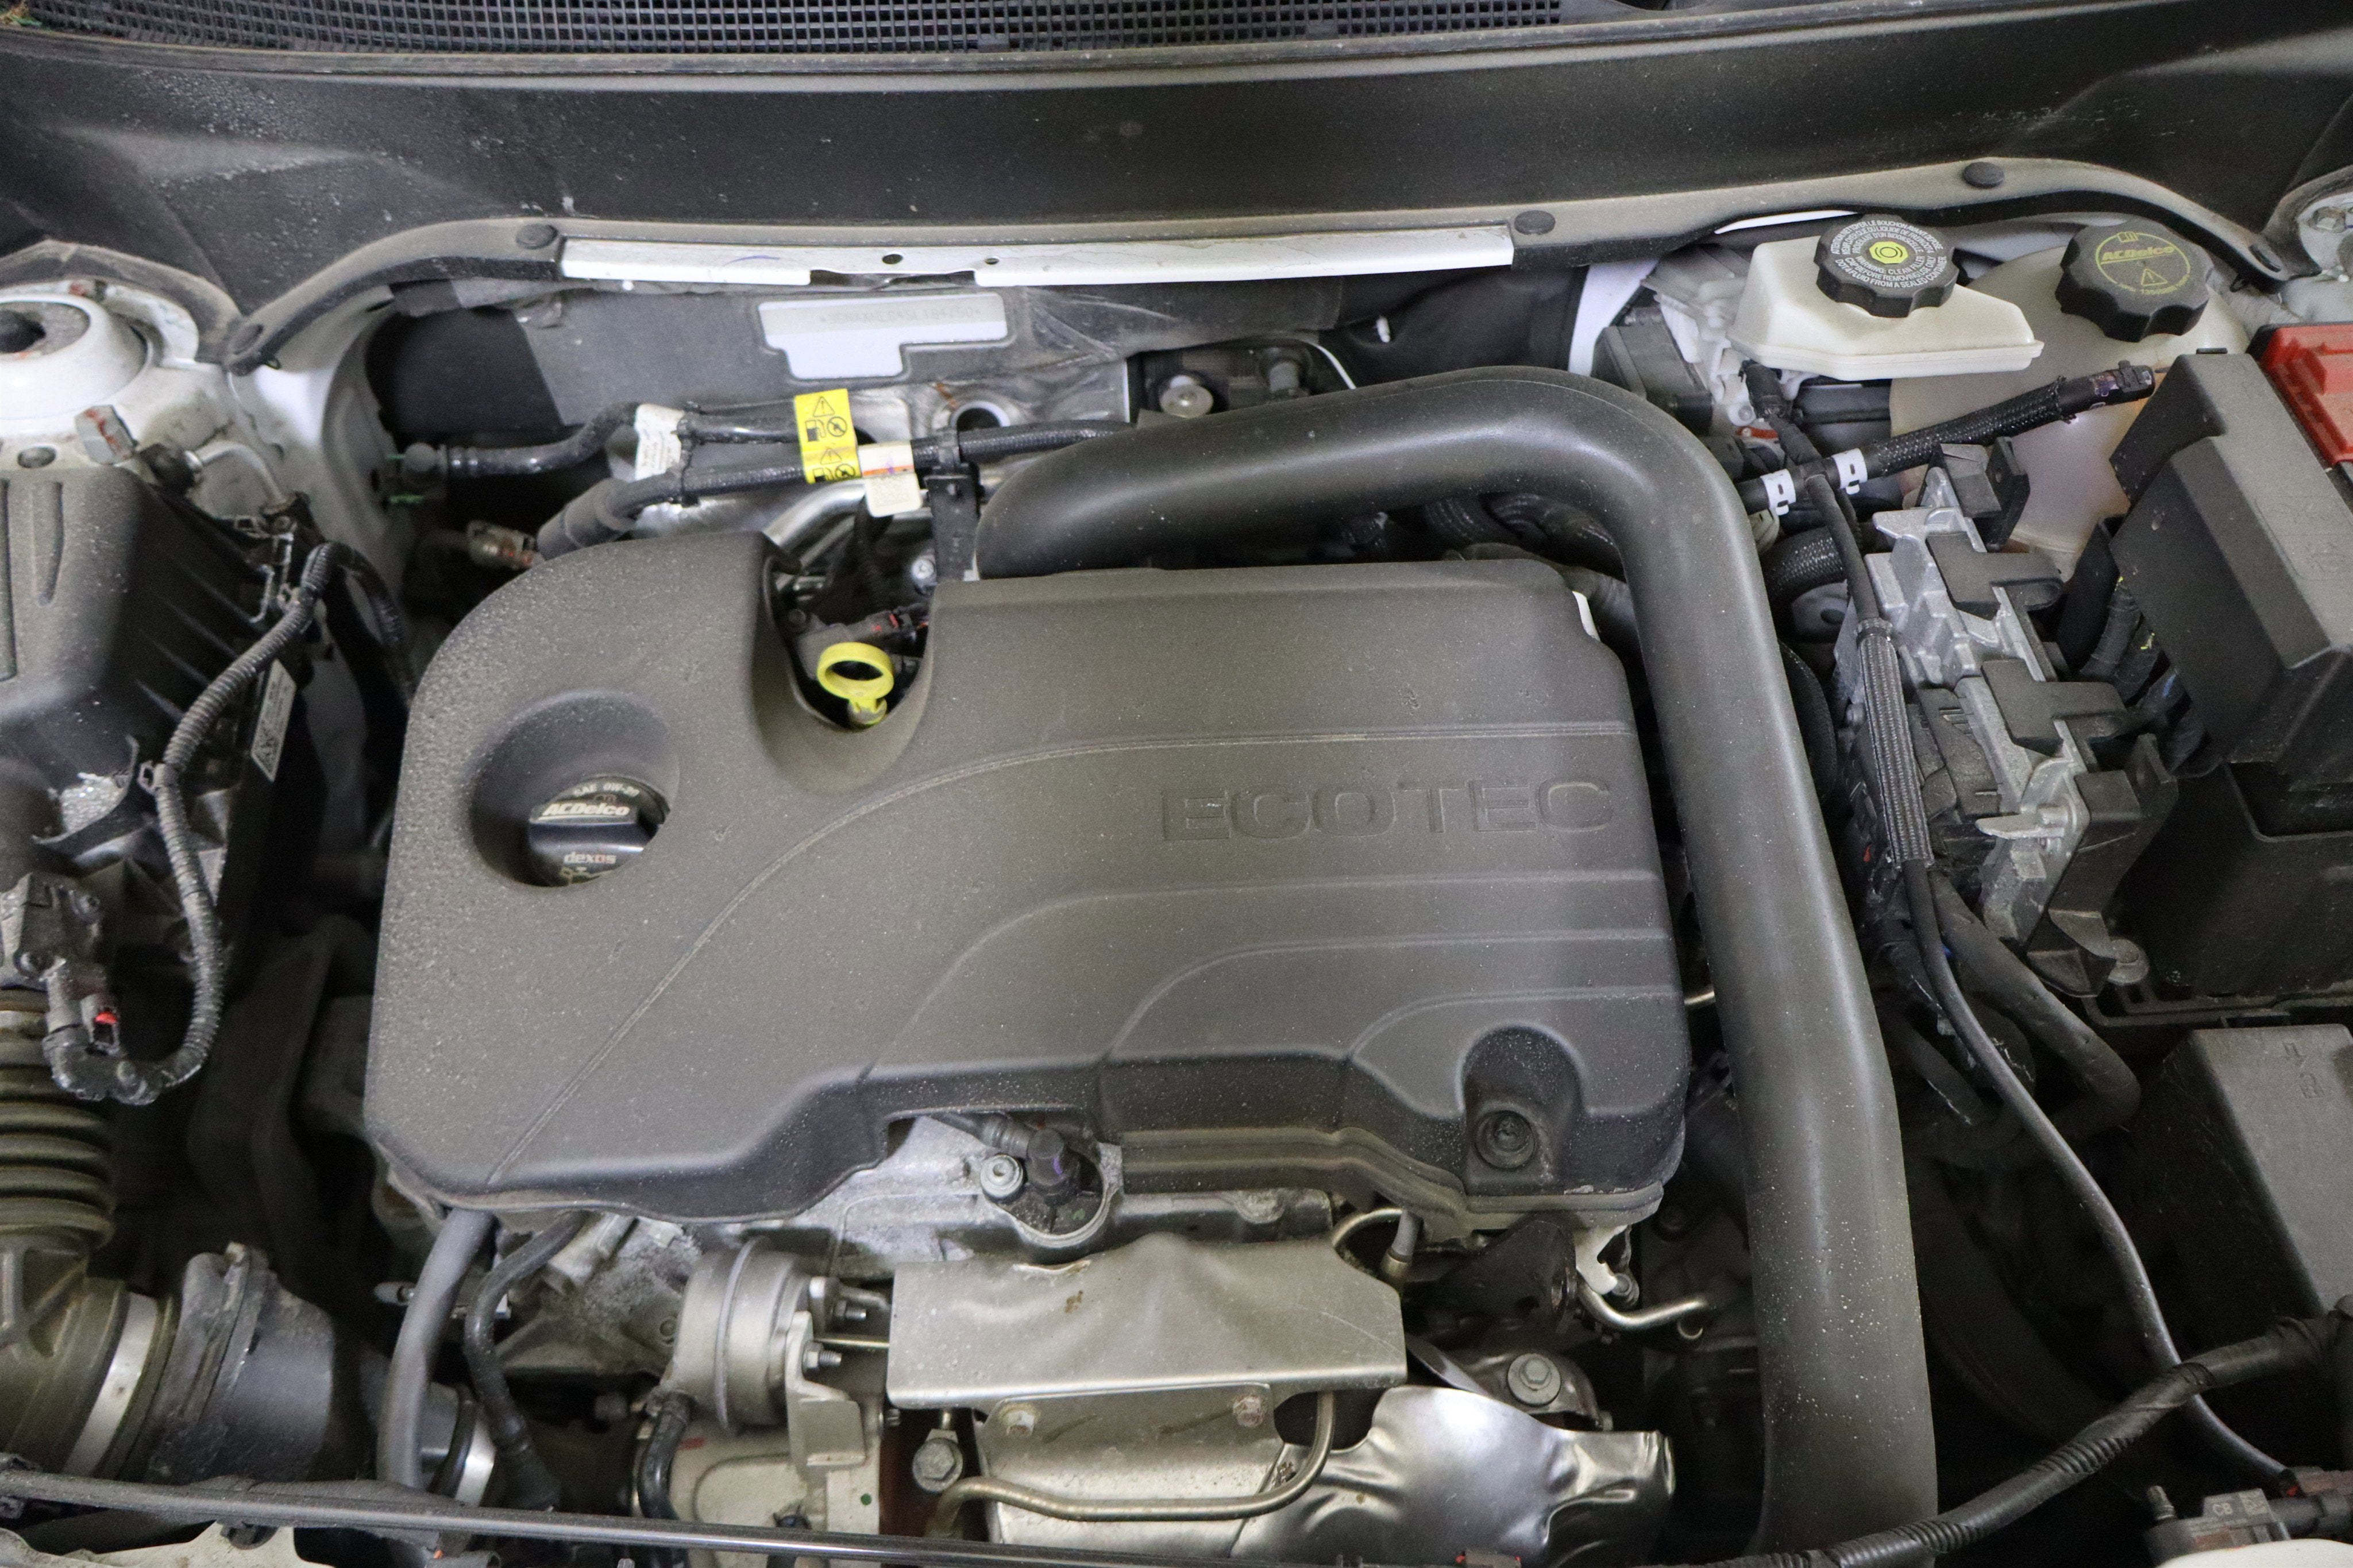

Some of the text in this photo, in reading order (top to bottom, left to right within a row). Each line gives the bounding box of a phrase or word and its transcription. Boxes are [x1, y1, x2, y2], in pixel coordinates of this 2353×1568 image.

[1876, 220, 1908, 229] BOUCHON
[1907, 226, 1928, 236] AVANT
[2102, 246, 2175, 261] ACDelco
[1845, 257, 1859, 267] CAP
[1854, 265, 1883, 279] BEFORE
[1916, 266, 1931, 275] USE
[1925, 256, 1936, 268] ONLY
[1849, 270, 1870, 282] FLUID
[1870, 278, 1893, 288] FROM
[1900, 277, 1928, 288] SEALED
[1926, 256, 1947, 281] CONTAINER
[1888, 267, 1913, 275] CLEAN
[1910, 256, 1925, 270] FILLER
[542, 803, 630, 816] ACDelco
[1160, 777, 1615, 841] ECOTEC
[564, 852, 616, 864] dexos
